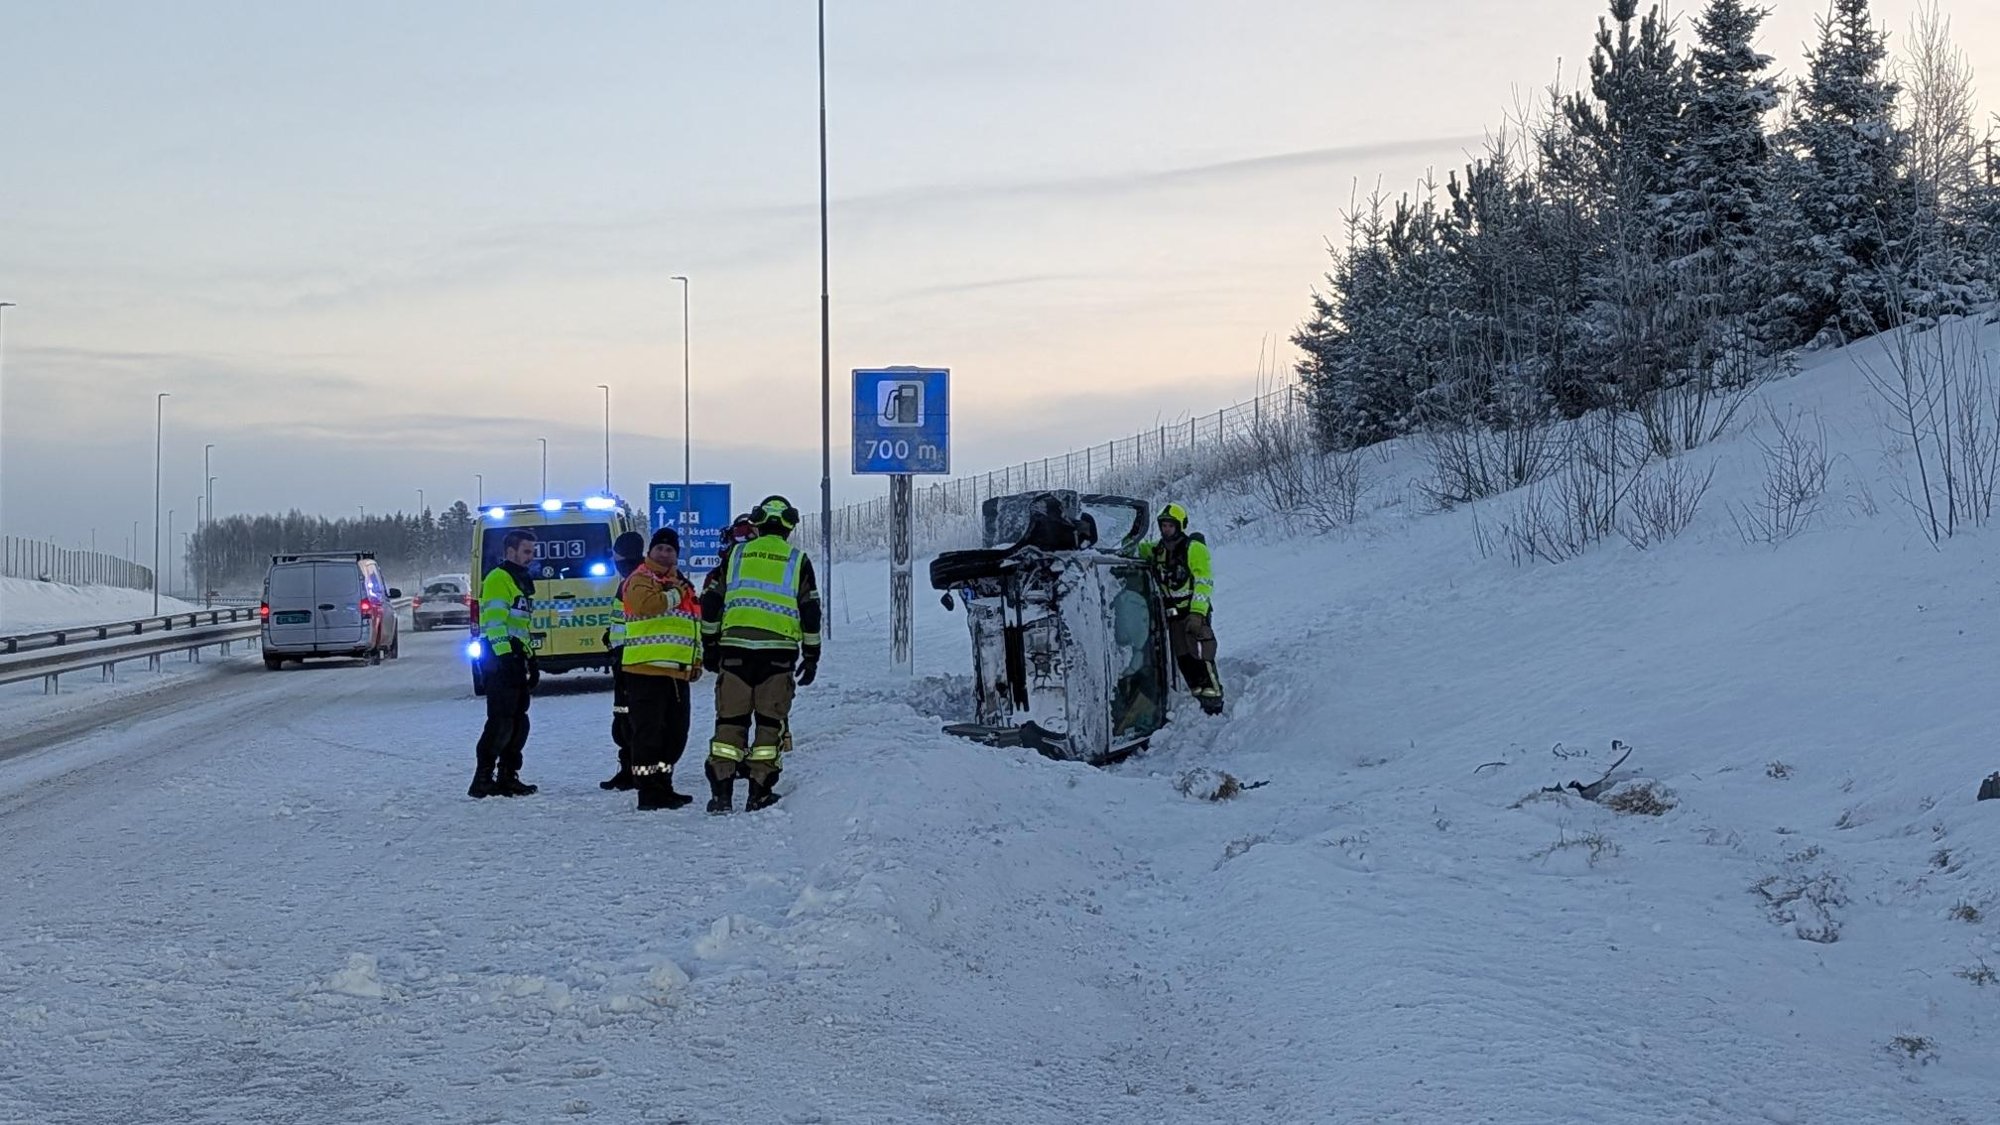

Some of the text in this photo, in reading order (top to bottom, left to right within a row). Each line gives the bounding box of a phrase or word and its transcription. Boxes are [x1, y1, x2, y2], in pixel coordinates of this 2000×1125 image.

[865, 439, 937, 460] 700 m
[677, 527, 722, 537] Rkkesta
[533, 541, 582, 558] 113
[679, 540, 706, 548] Akim
[707, 557, 720, 566] 119
[533, 613, 613, 629] ULANSE
